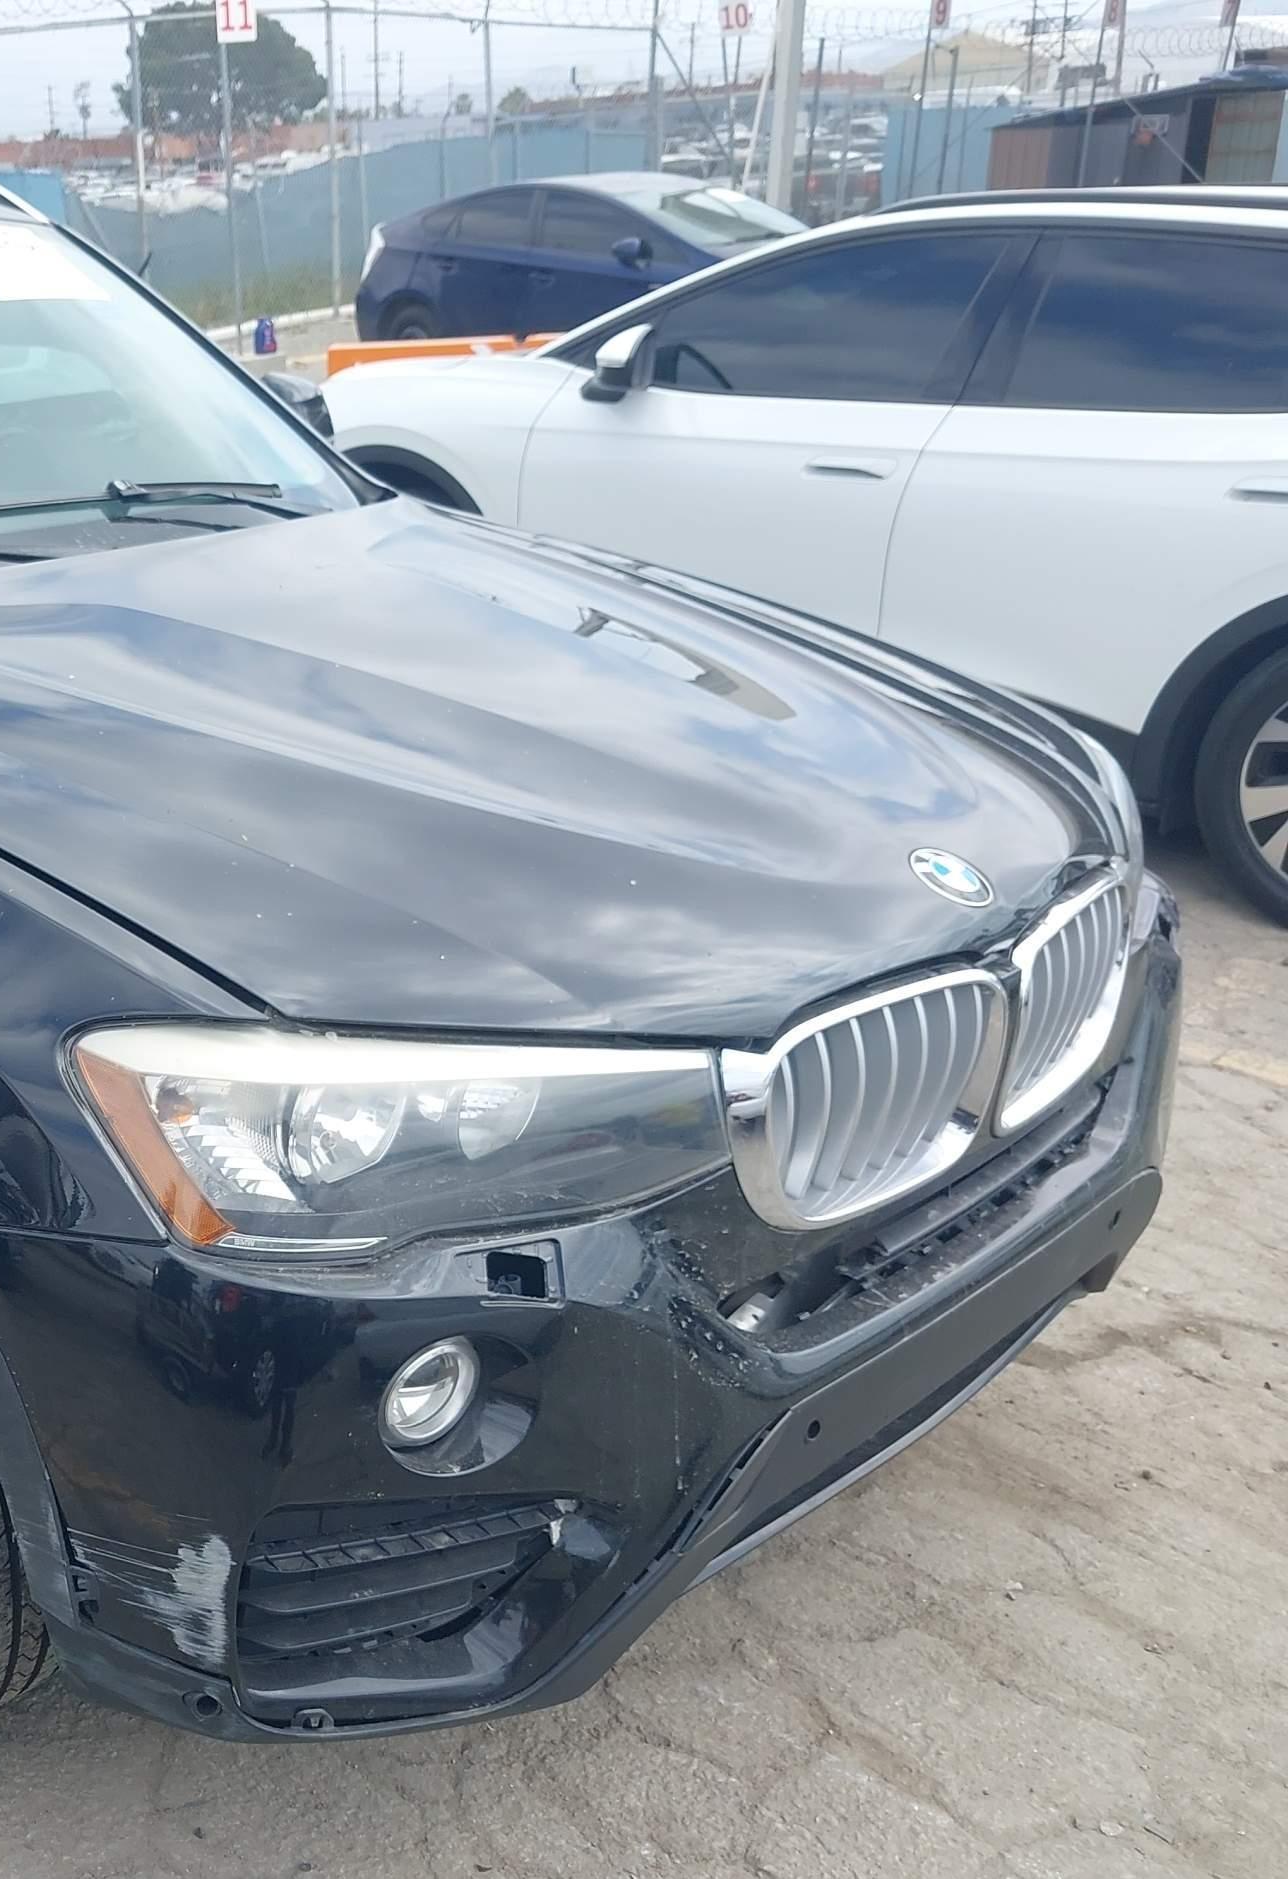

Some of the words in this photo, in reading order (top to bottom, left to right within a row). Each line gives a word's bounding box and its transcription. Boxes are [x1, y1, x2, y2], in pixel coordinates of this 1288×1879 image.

[220, 0, 252, 31] 11
[721, 4, 748, 29] 10
[935, 0, 947, 26] 9
